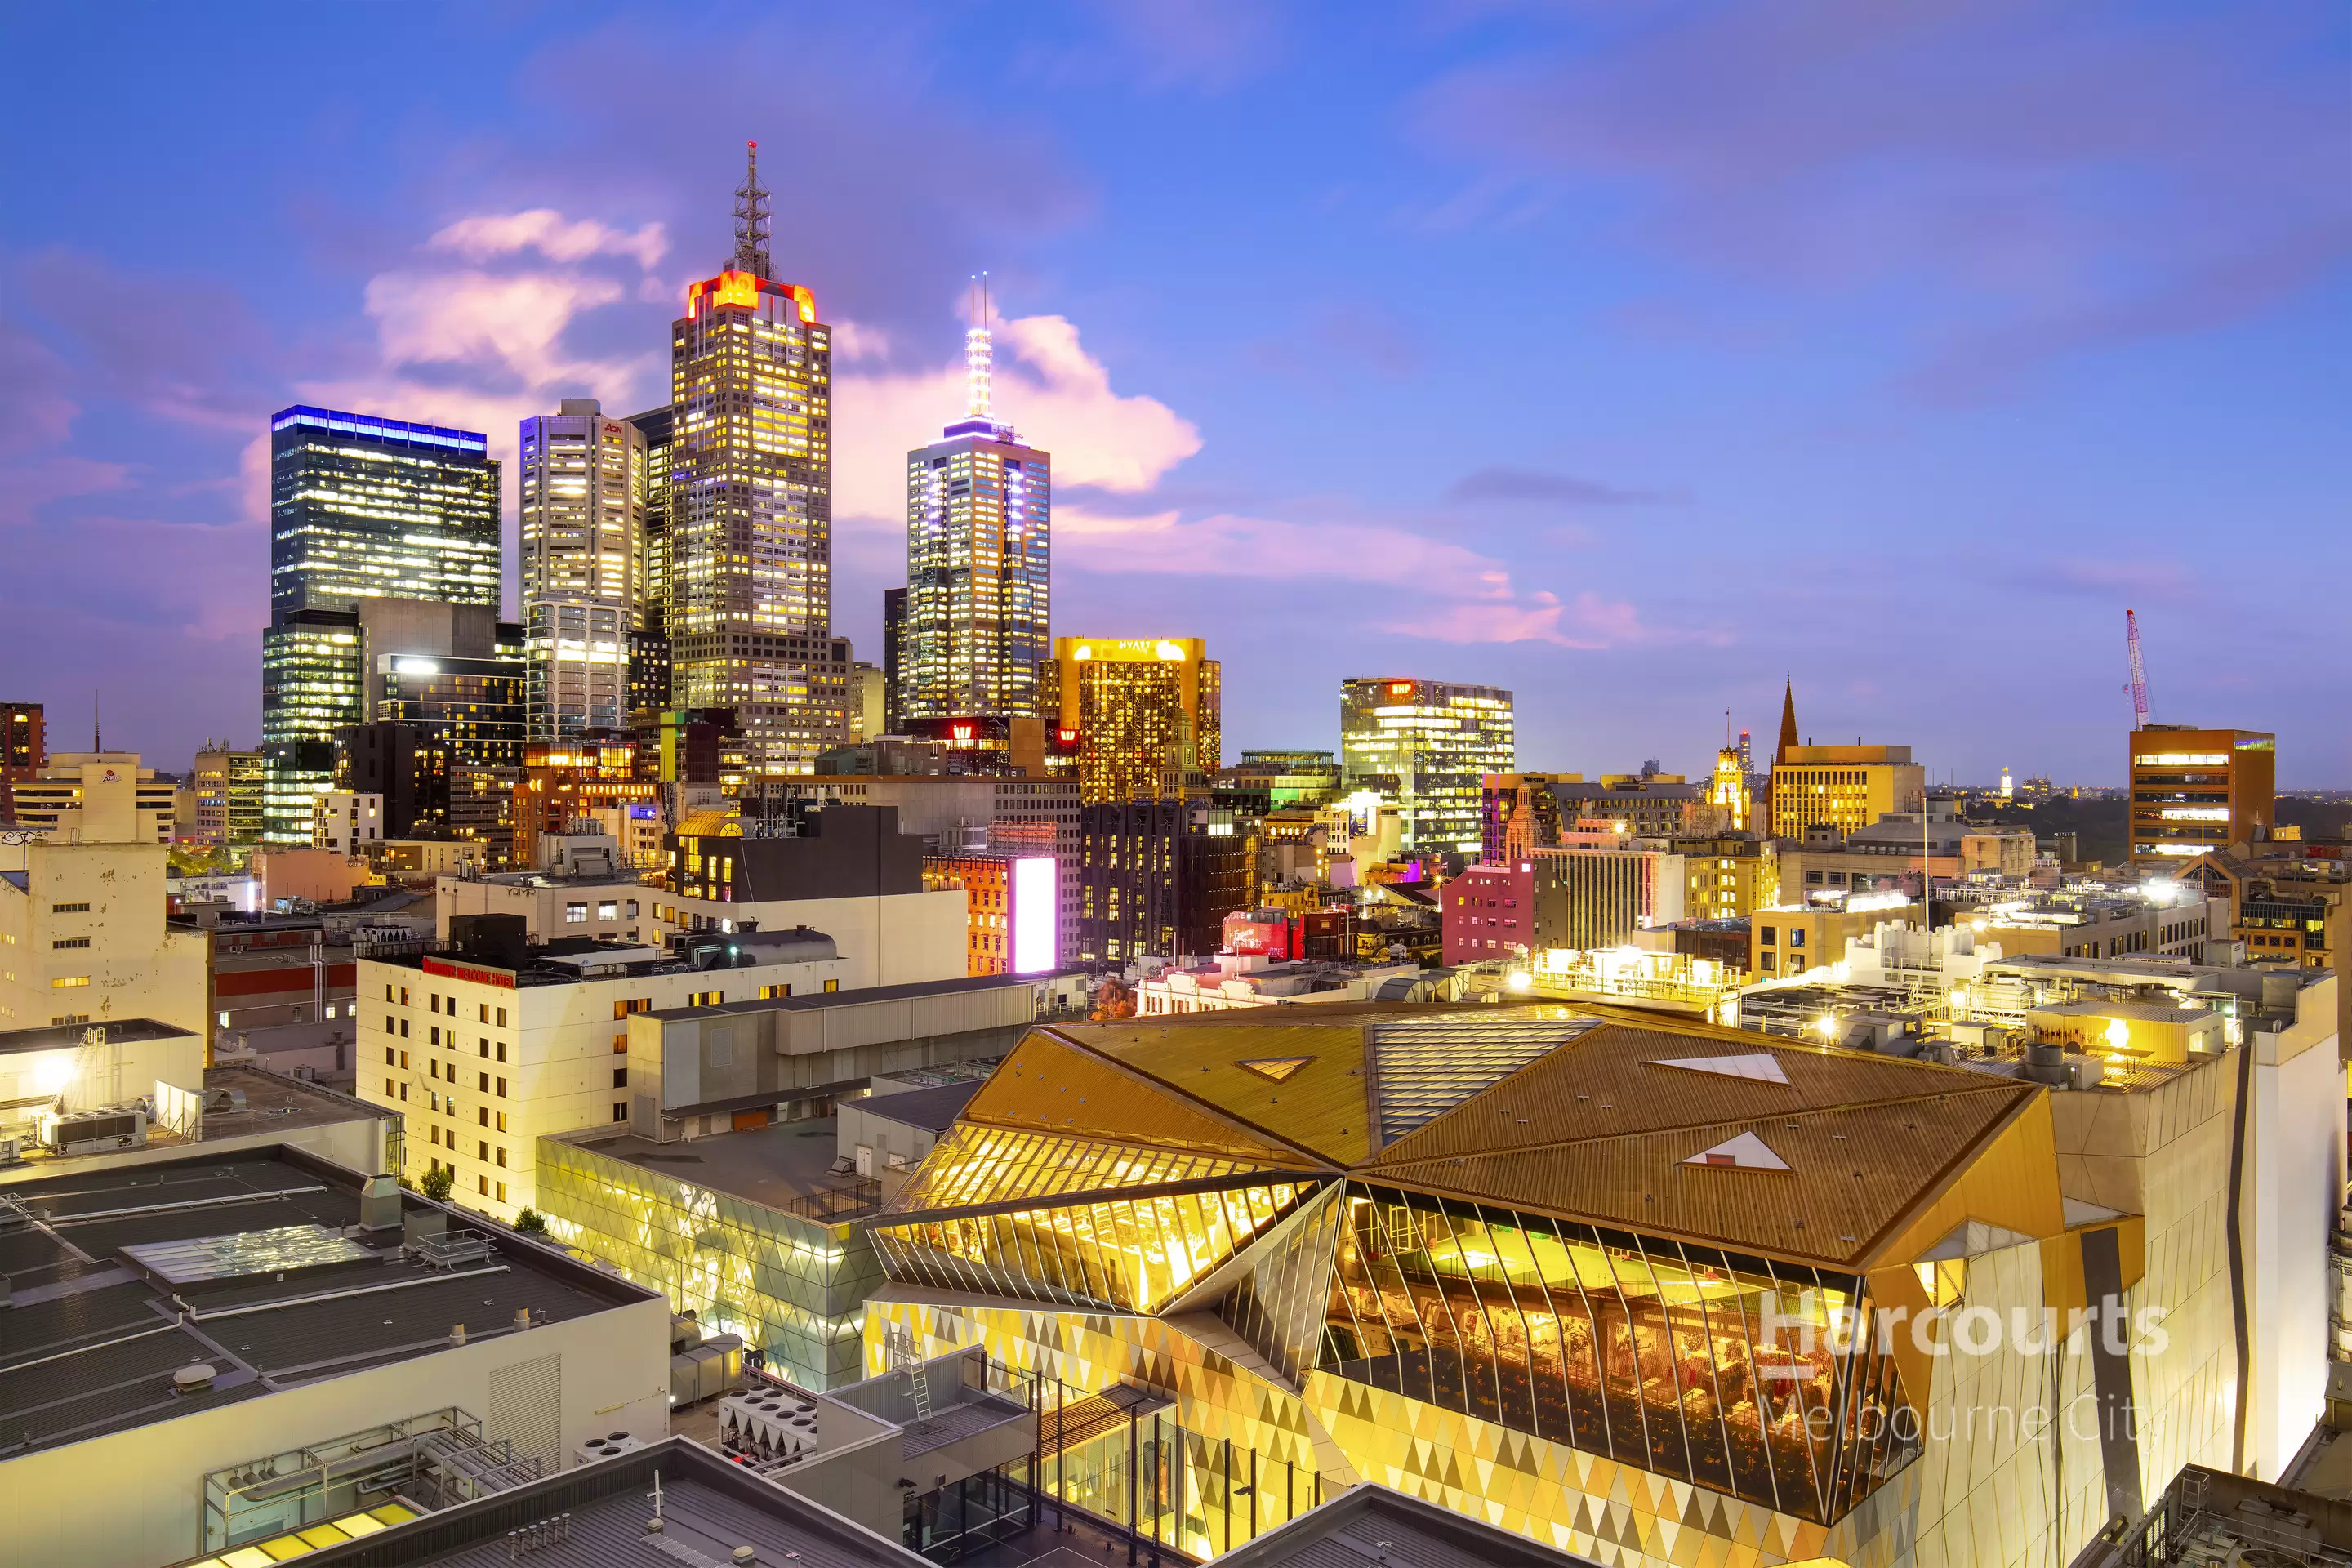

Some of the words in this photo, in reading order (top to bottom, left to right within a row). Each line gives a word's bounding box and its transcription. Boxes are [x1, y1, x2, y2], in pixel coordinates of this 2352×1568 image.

[604, 423, 622, 434] AON
[1119, 641, 1150, 650] HYATT
[1392, 684, 1411, 694] BHP
[457, 967, 491, 984] WELCOME
[492, 973, 515, 990] HOTEL
